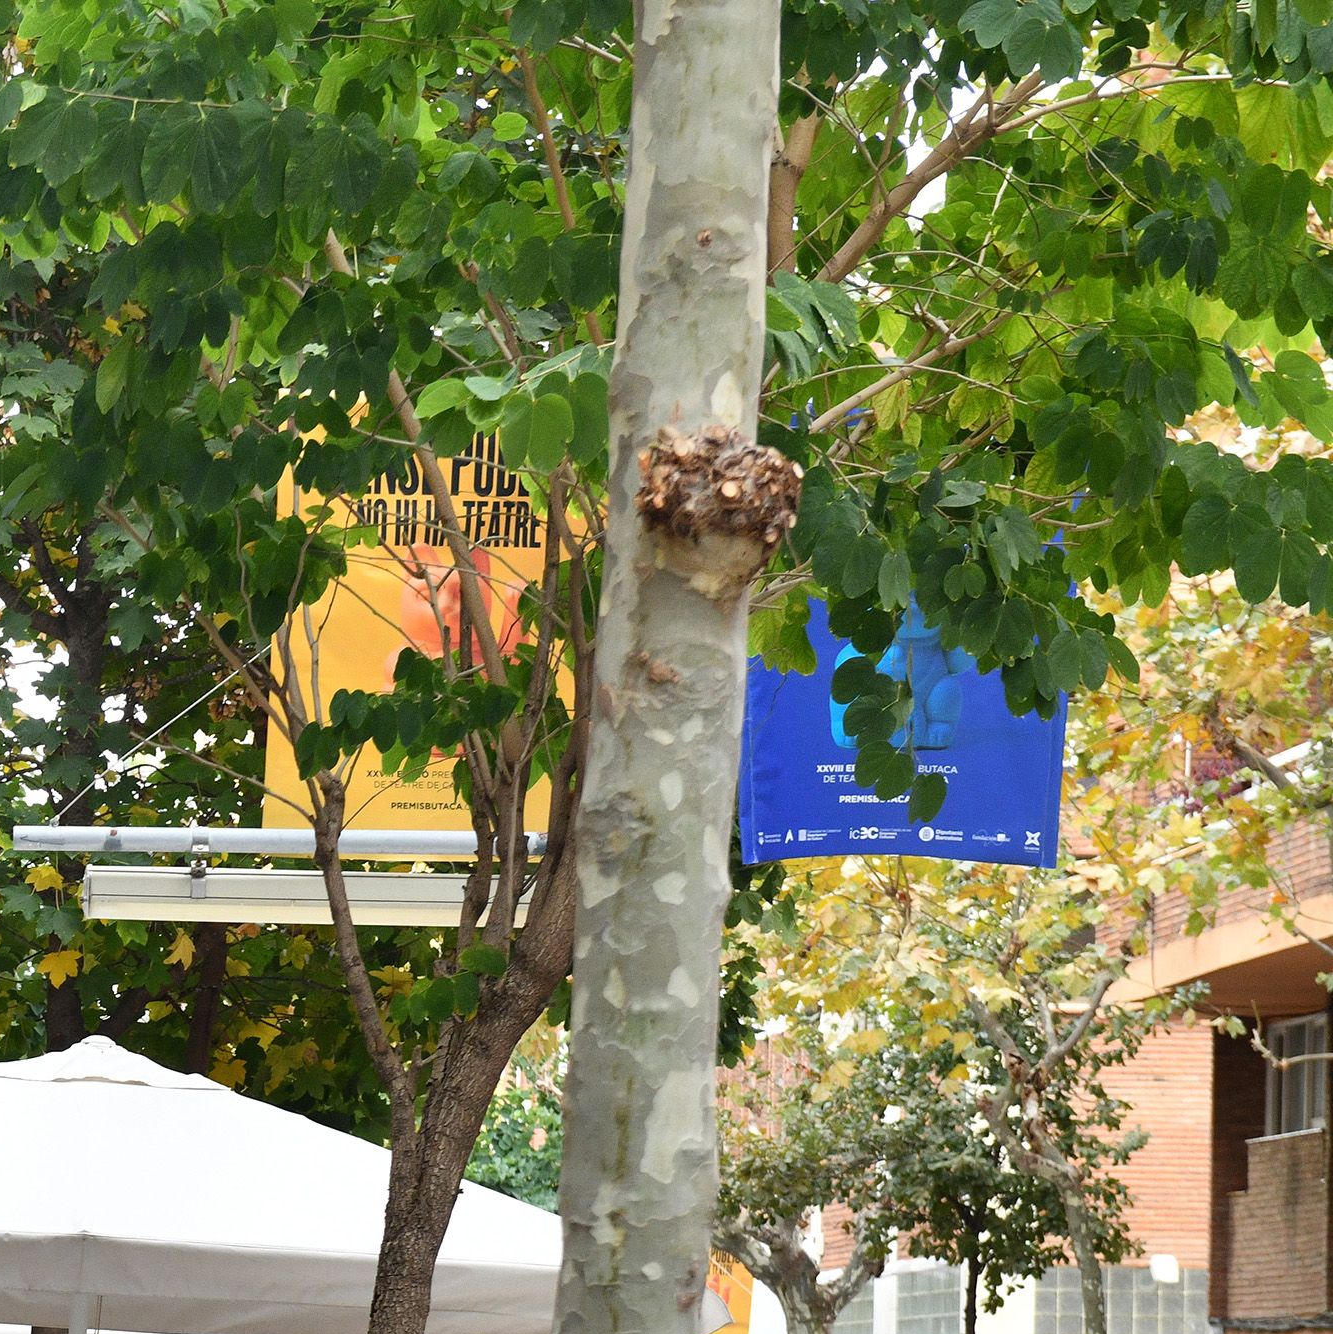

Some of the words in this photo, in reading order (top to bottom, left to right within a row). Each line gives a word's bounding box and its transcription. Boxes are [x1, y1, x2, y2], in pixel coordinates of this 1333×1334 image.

[395, 499, 418, 546] HI
[463, 500, 541, 548] TEATRE
[918, 764, 958, 774] BUTACA
[432, 770, 454, 778] PRE
[823, 775, 835, 783] DE
[838, 774, 856, 783] TEA
[374, 781, 386, 789] DE
[427, 781, 440, 789] DE
